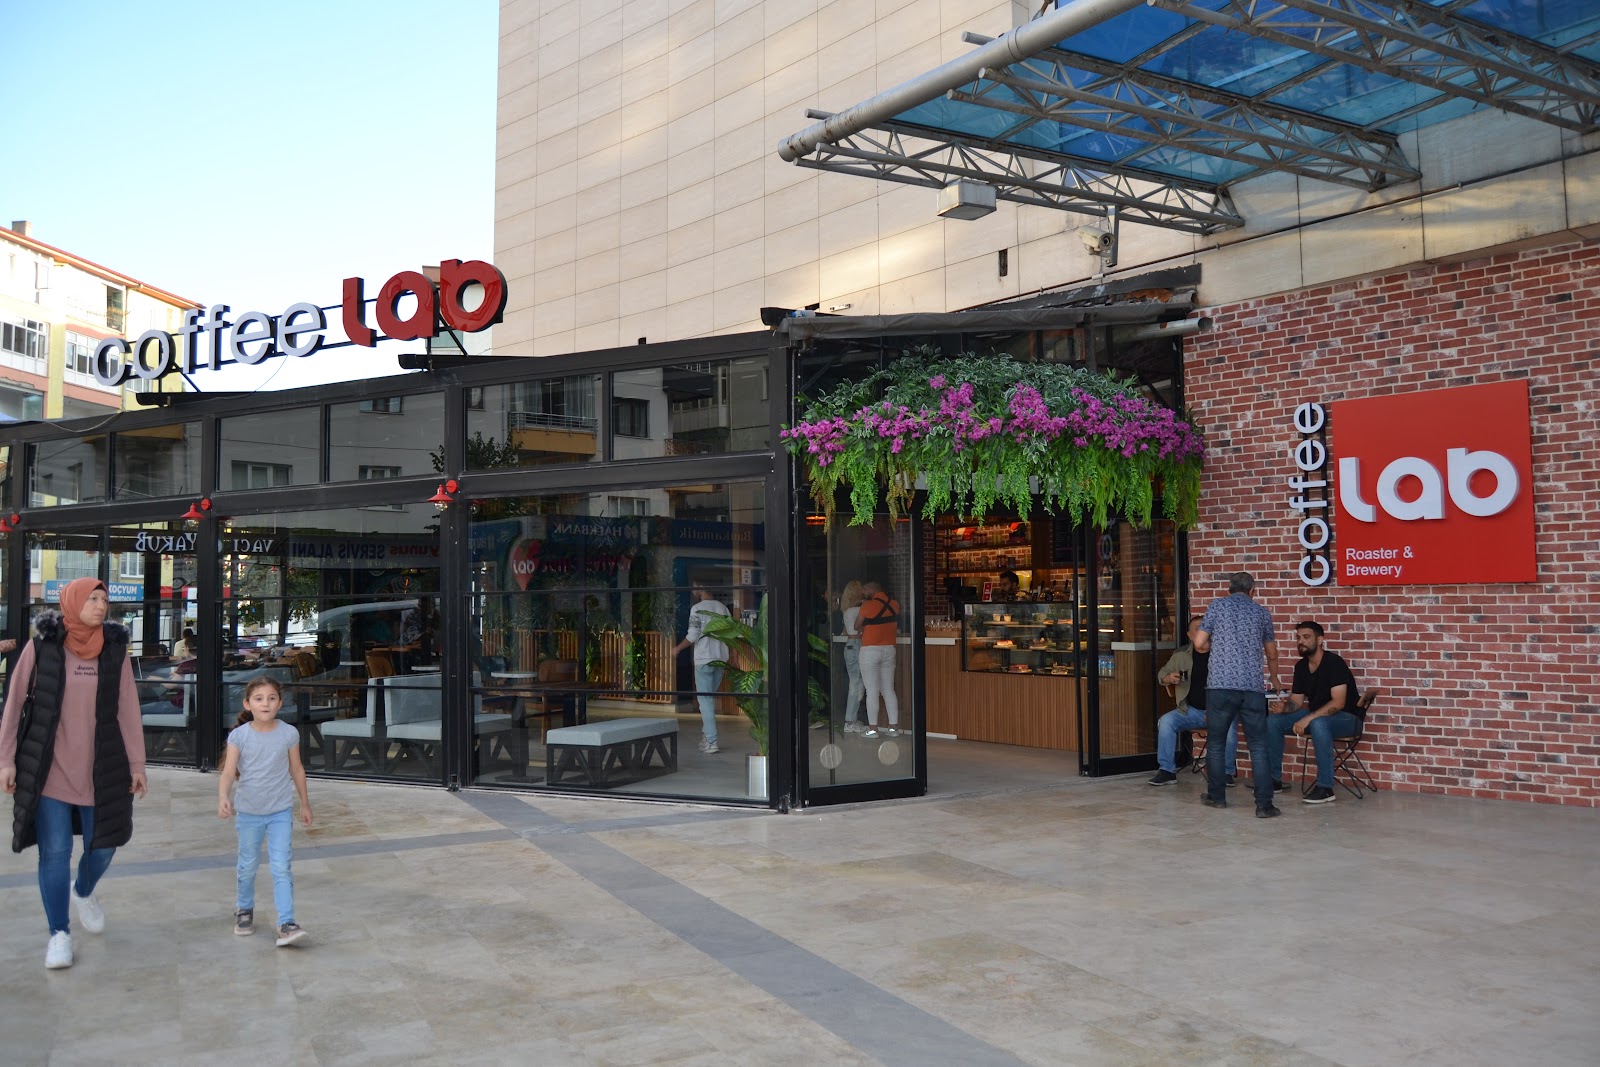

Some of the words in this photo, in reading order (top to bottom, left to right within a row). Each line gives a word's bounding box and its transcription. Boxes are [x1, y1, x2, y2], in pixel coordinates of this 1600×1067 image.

[92, 302, 327, 386] coffee
[342, 258, 508, 347] lab
[1288, 402, 1331, 586] coffee
[1338, 448, 1520, 523] lab
[513, 559, 535, 575] lab
[1345, 548, 1398, 560] Roaster
[1403, 546, 1413, 558] &
[1346, 563, 1402, 578] Brewery
